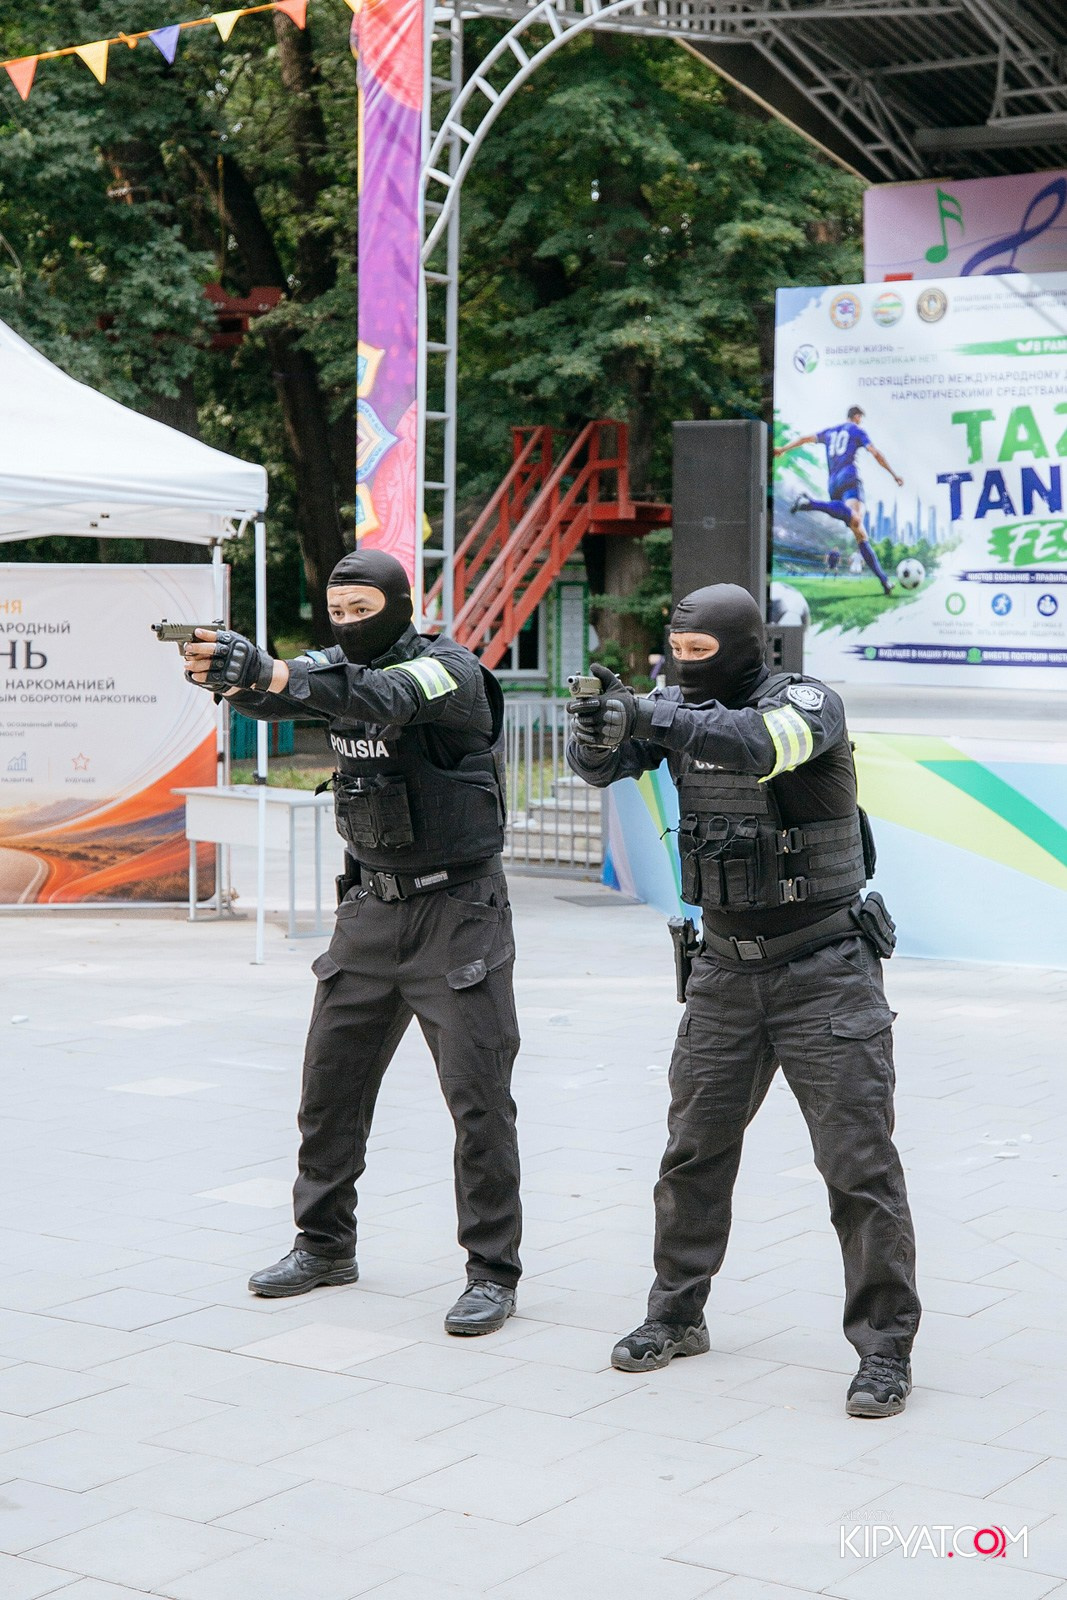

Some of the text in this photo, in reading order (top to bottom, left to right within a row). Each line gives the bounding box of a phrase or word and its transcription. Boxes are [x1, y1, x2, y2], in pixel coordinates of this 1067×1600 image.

[825, 346, 860, 355] ВЫБЕРИ
[863, 344, 894, 353] ЖИЗНЬ
[858, 374, 944, 387] ПОСВЯЩЁННОГО
[948, 370, 1059, 384] МЕЖДУНАРОДНОМУ
[891, 388, 993, 400] НАРКОТИЧЕСКИМИ
[829, 430, 850, 457] 10
[937, 465, 1063, 521] TAN
[879, 648, 910, 658] БУДУЩЕЕ
[911, 649, 917, 658] В
[917, 649, 942, 659] НАШИХ
[5, 677, 115, 690] НАРКОМАНИЕЙ
[20, 694, 81, 703] ОБОРОТОМ
[85, 694, 157, 703] НАРКОТИКОВ
[330, 734, 390, 759] POLISIA
